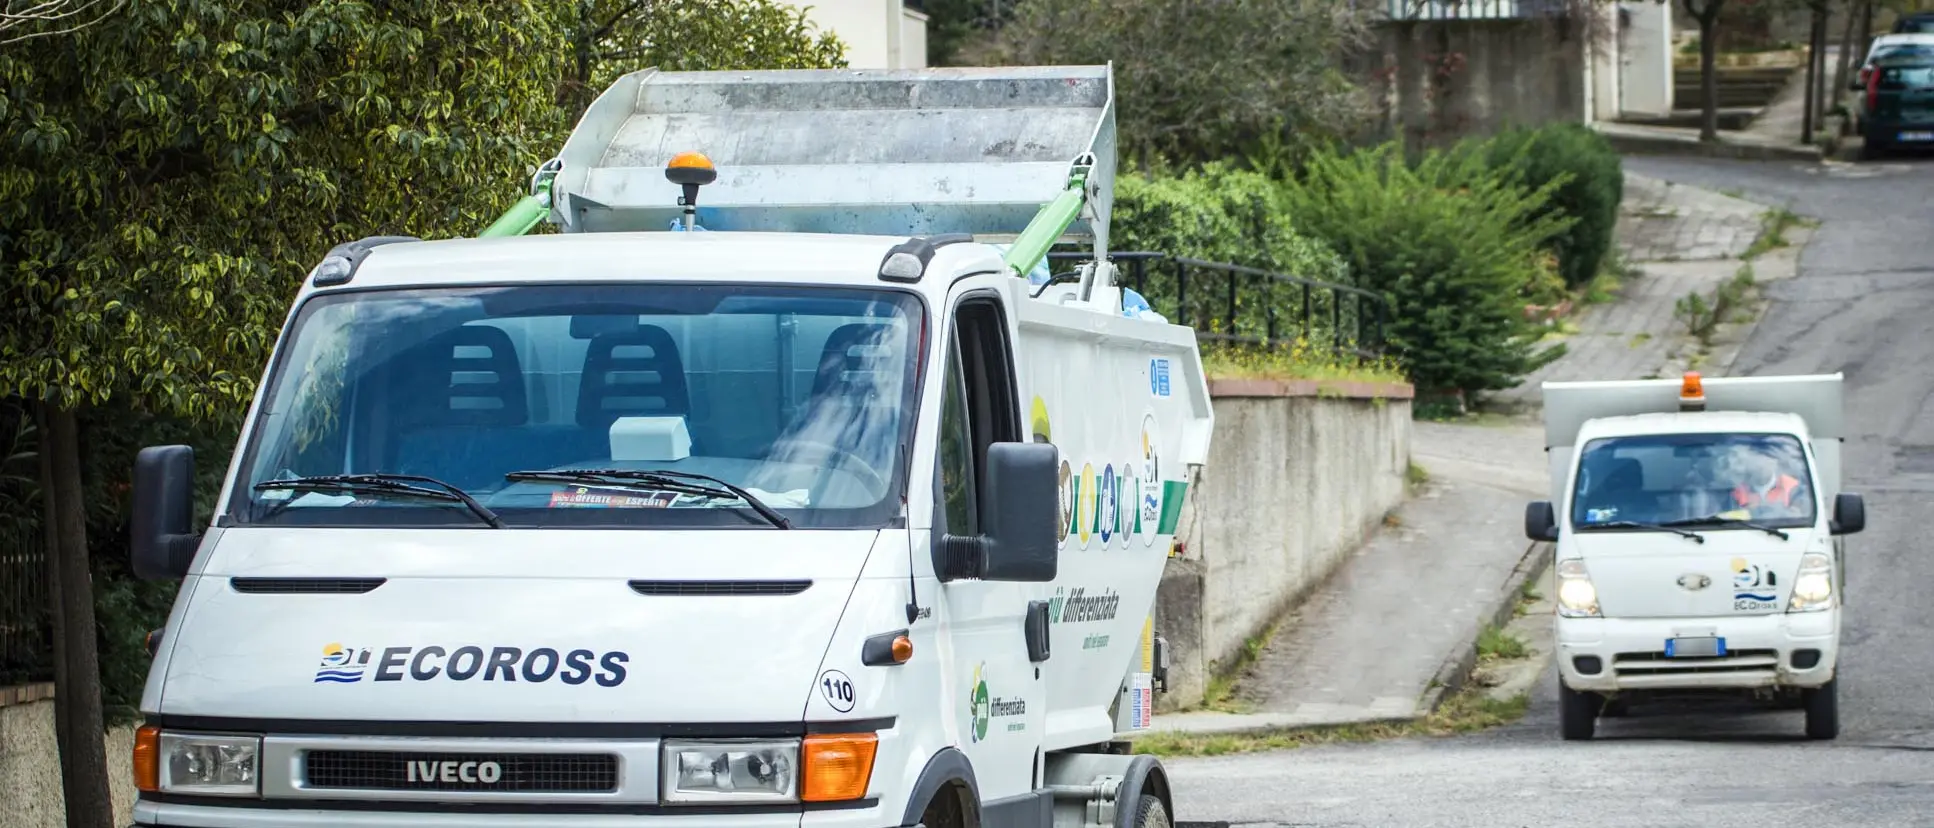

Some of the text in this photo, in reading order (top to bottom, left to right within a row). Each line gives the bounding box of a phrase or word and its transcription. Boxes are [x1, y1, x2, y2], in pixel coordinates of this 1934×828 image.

[1062, 587, 1119, 622] differenziata
[374, 645, 630, 687] ECOROSS
[824, 678, 853, 702] 110
[991, 696, 1026, 717] differenziata
[407, 760, 501, 784] IVECO
